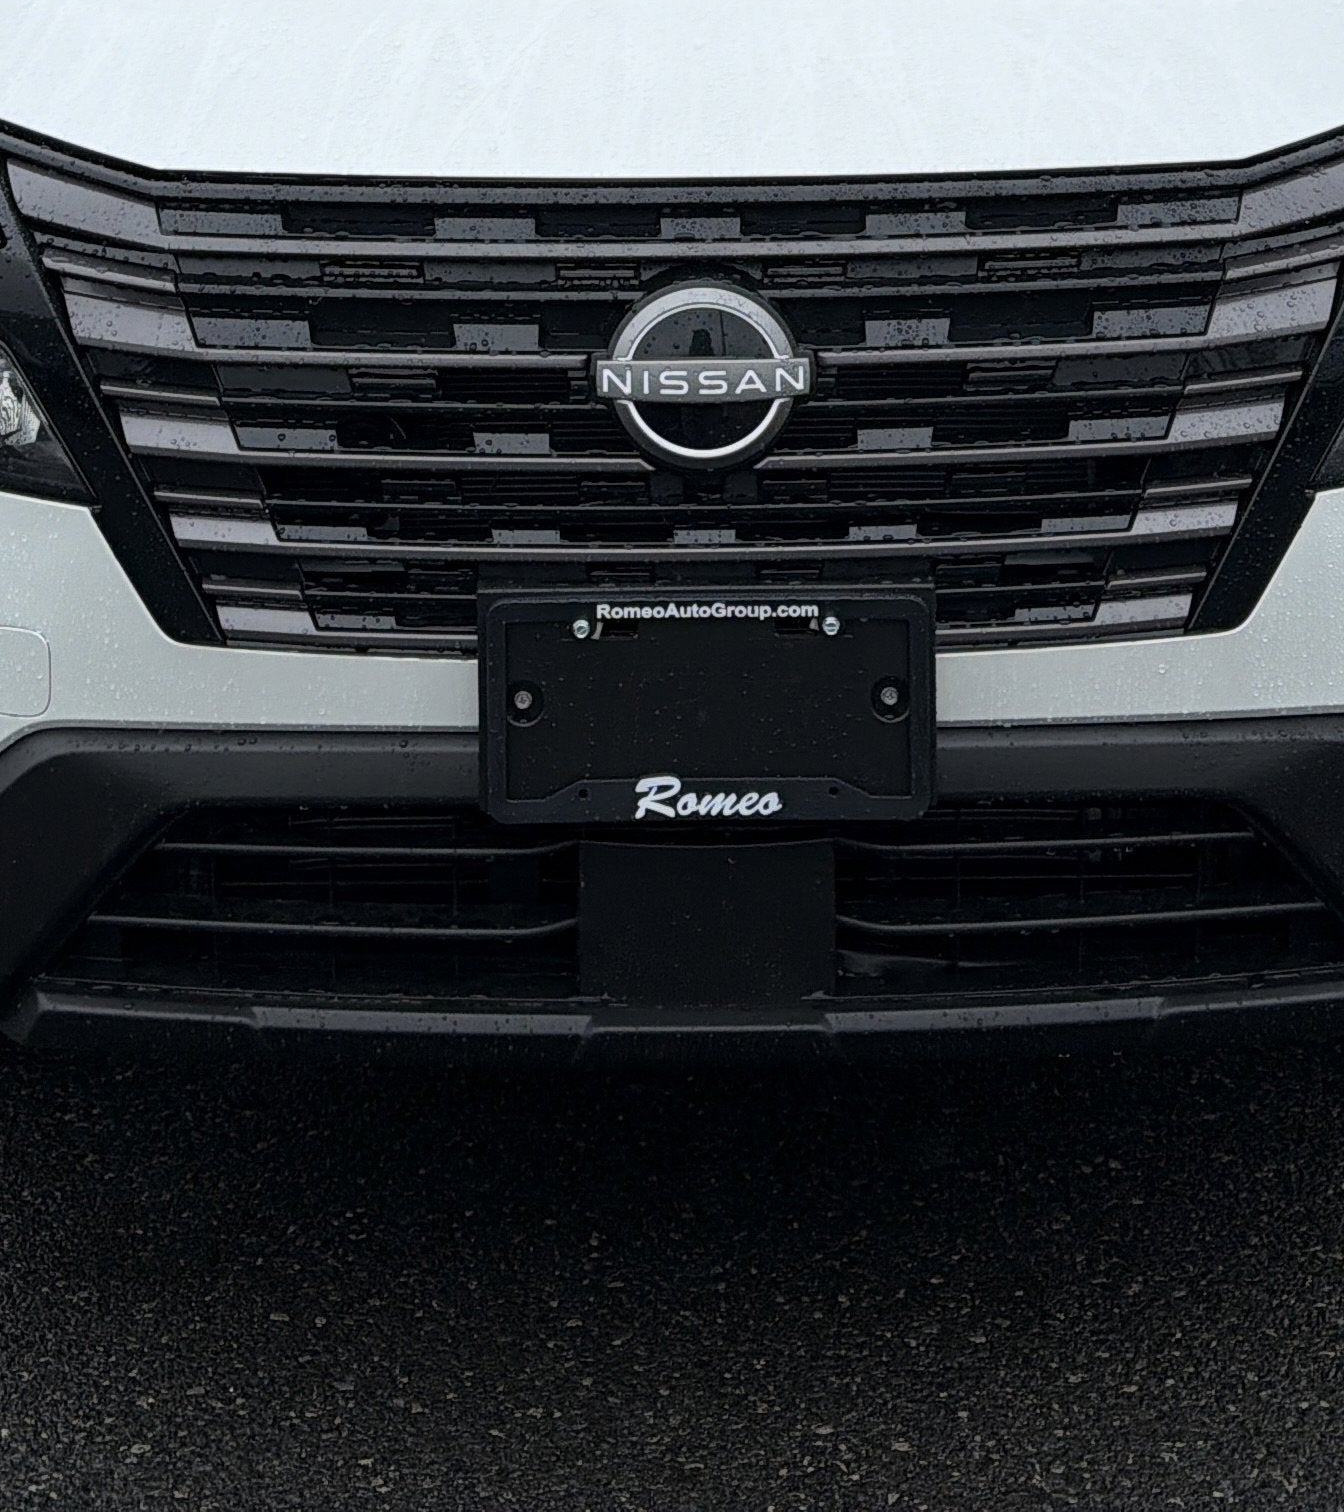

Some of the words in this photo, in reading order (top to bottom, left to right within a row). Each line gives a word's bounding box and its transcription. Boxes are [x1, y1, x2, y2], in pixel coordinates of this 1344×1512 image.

[602, 365, 805, 395] NISSAN
[596, 602, 819, 620] RomeoAutoGroup.com
[634, 776, 783, 819] Romeo
